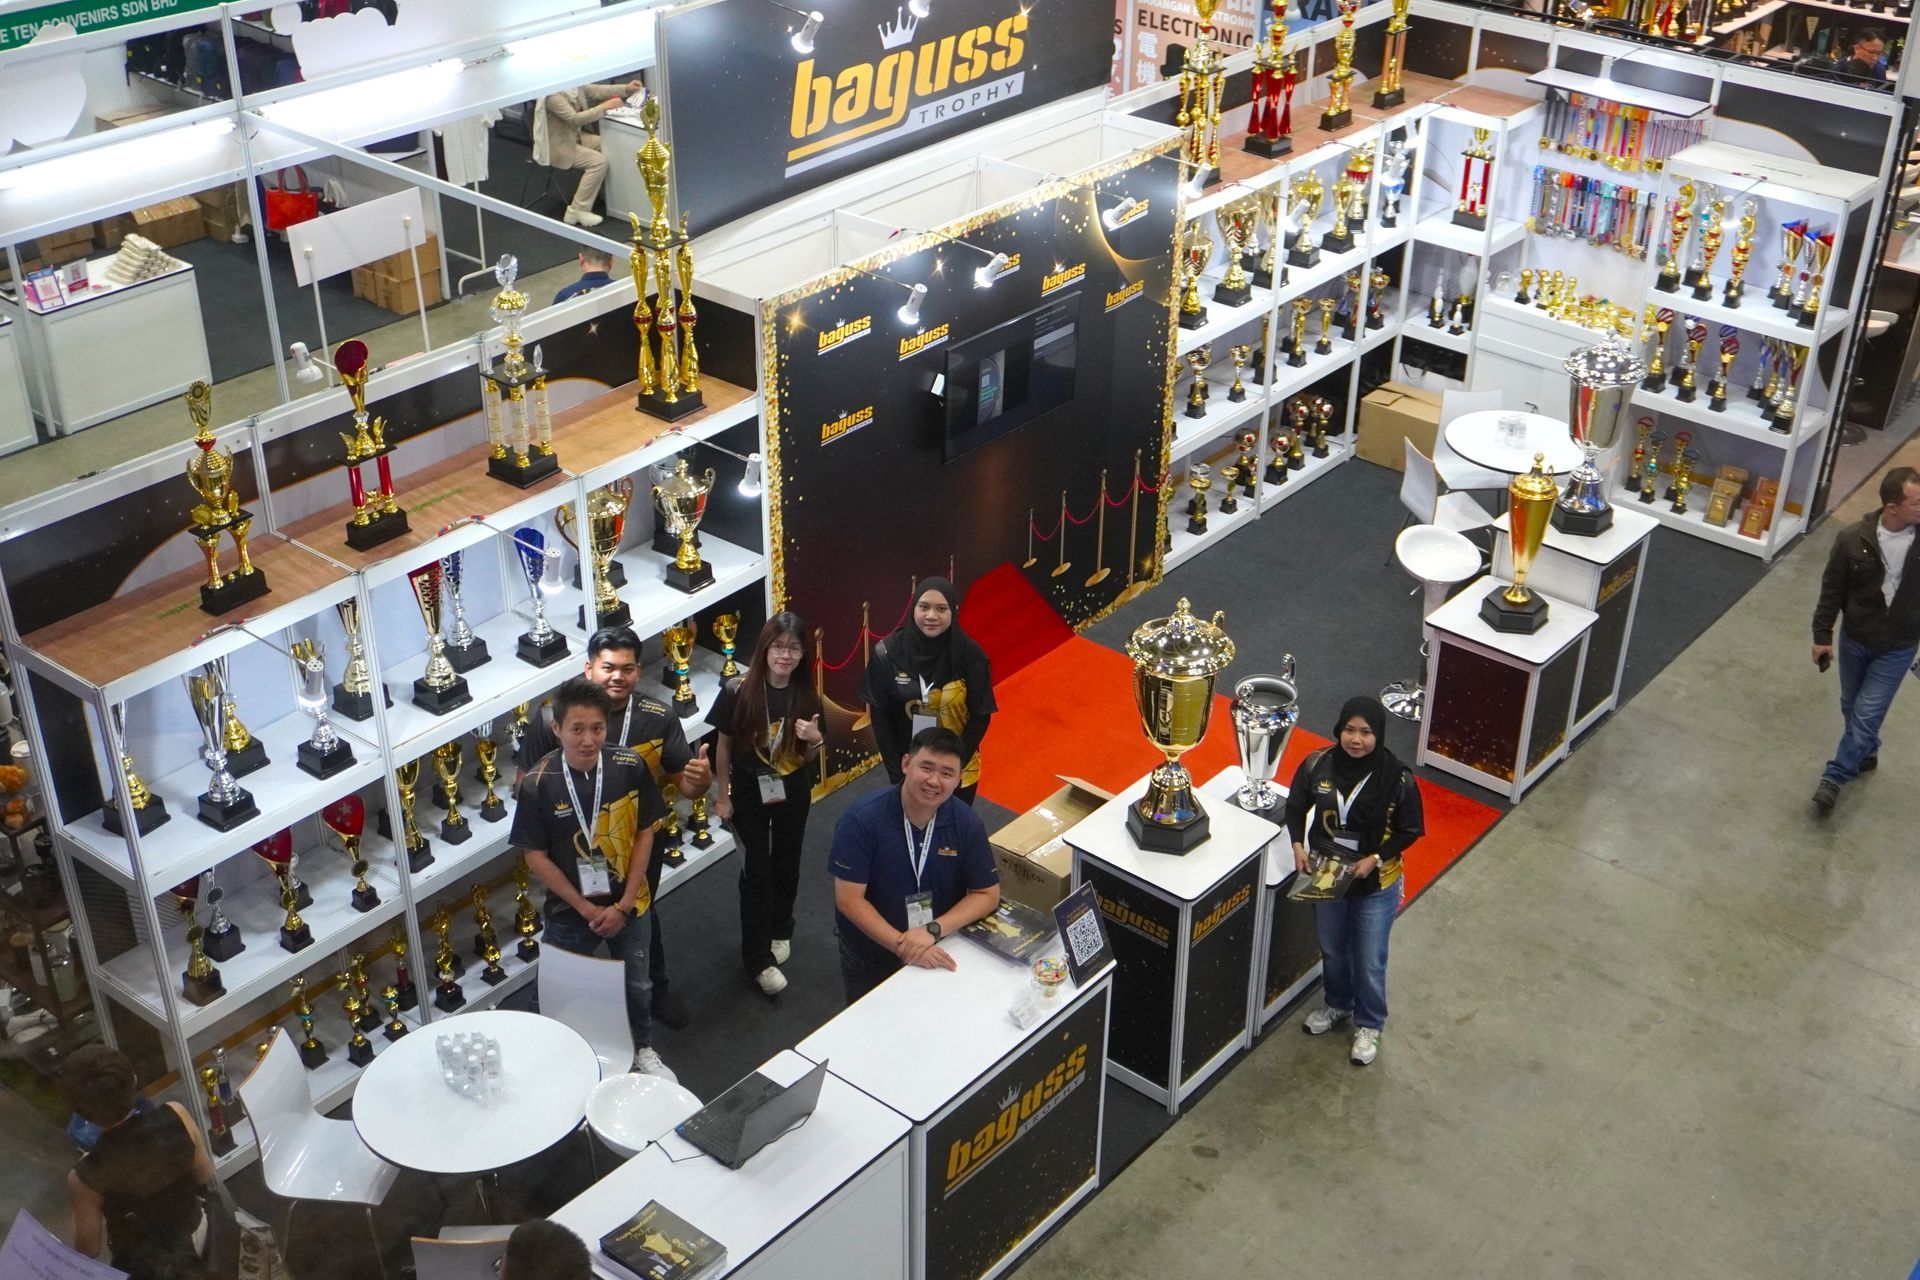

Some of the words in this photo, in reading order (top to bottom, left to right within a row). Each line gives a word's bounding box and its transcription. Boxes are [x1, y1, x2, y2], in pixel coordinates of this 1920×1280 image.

[10, 22, 39, 41] TEN
[121, 0, 149, 17] SDN
[789, 14, 1029, 140] baguss
[918, 80, 1015, 124] TROPHY
[1042, 262, 1086, 291] baguss
[1105, 279, 1144, 307] baguss
[819, 315, 871, 348] baguss
[900, 323, 949, 354] baguss
[821, 405, 873, 440] baguss
[1193, 884, 1250, 939] baguss
[947, 1043, 1087, 1180] baguss
[1024, 1078, 1080, 1131] TROPHY
